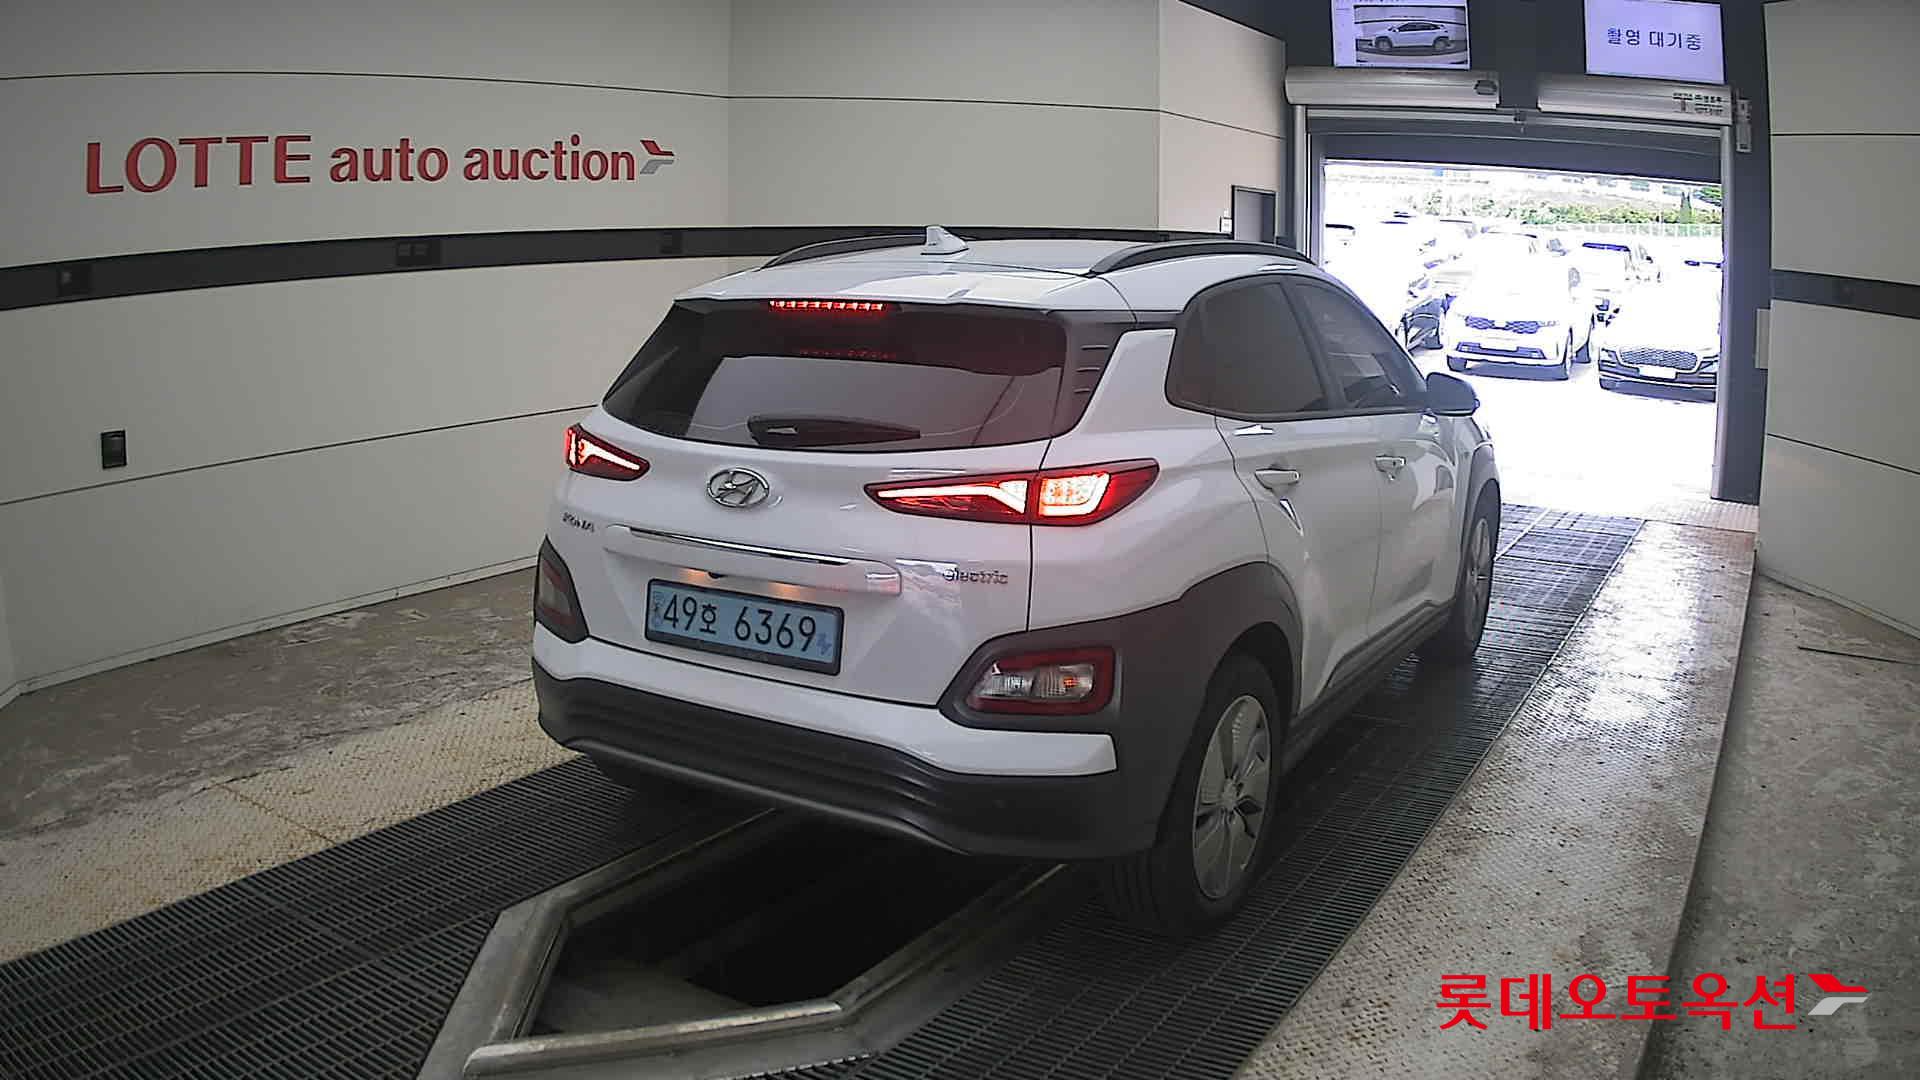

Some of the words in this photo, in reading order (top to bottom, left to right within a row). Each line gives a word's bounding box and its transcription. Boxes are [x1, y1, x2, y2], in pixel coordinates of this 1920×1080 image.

[1648, 31, 1701, 51] 대기중
[86, 134, 312, 195] LOTTE
[329, 138, 450, 184] auto
[463, 133, 637, 182] auction
[662, 593, 718, 635] 49호
[734, 606, 817, 652] 6369
